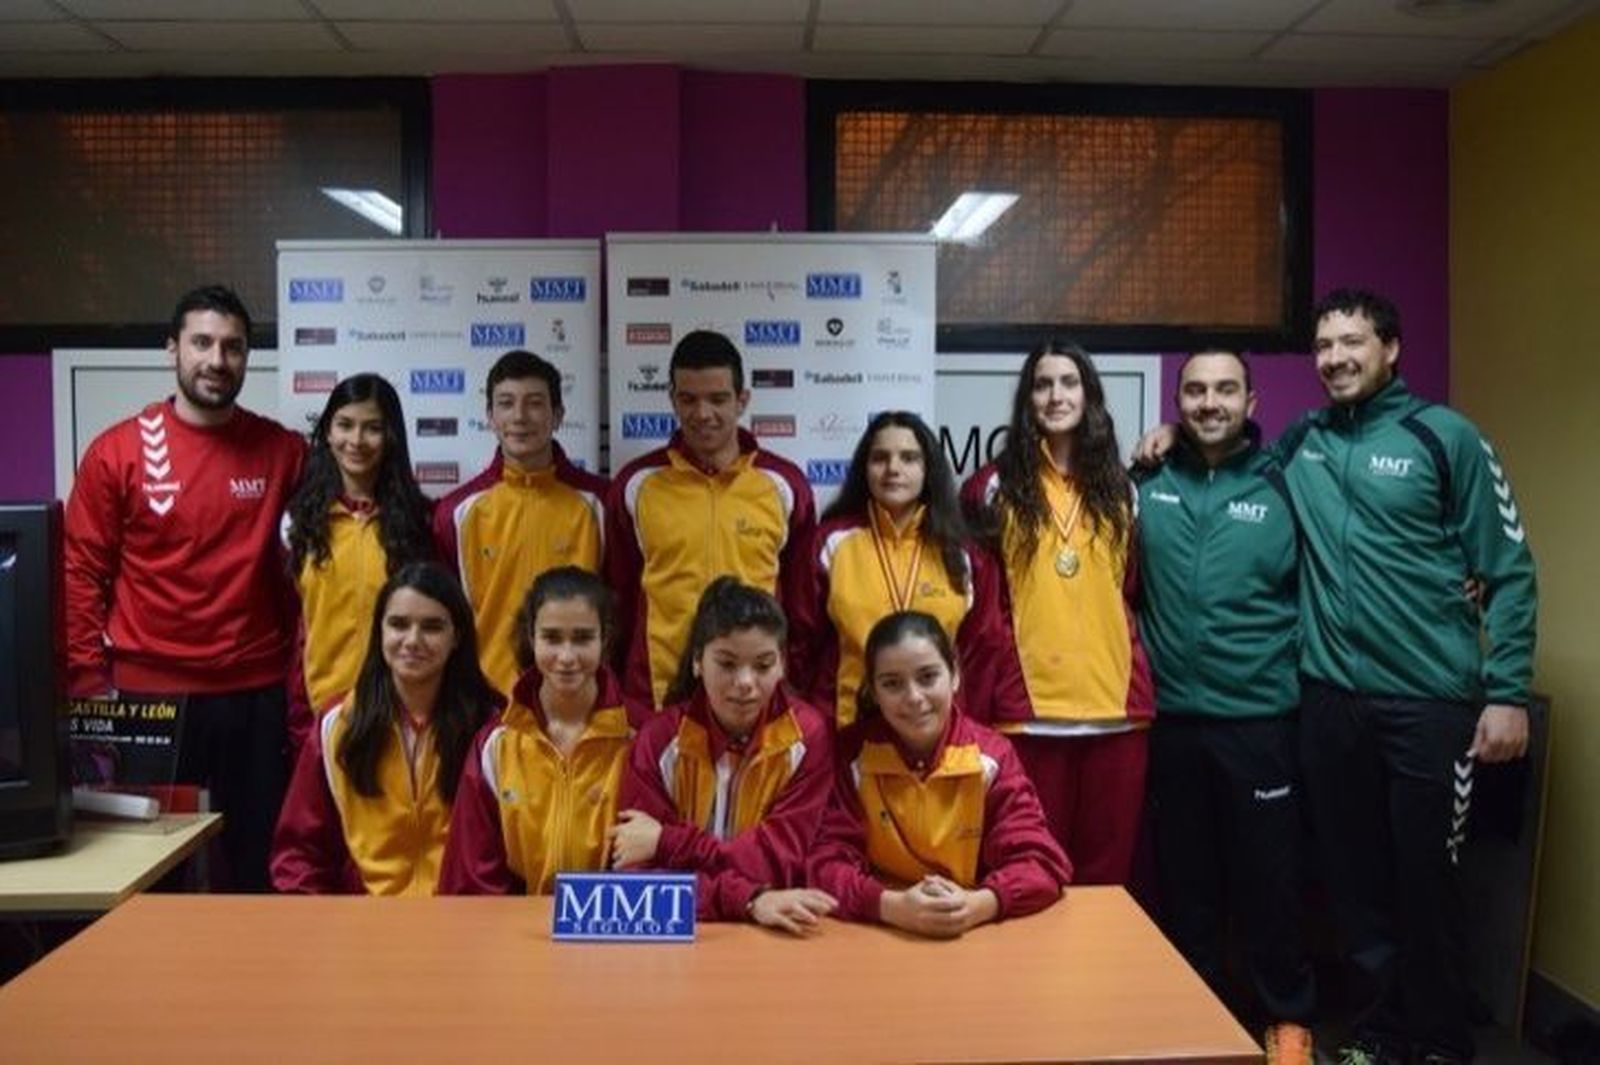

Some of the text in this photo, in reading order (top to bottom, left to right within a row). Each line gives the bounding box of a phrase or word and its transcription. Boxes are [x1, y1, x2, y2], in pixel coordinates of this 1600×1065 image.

[533, 281, 583, 297] MMT
[808, 275, 859, 294] MMT
[472, 326, 524, 343] MMT
[747, 324, 798, 340] MMT
[413, 372, 462, 389] MMT
[808, 461, 848, 480] MM
[1368, 457, 1412, 474] MMT
[230, 478, 266, 492] MMT
[1227, 501, 1268, 516] MMT
[70, 701, 176, 719] ASTILLA Y LEÓN
[82, 719, 114, 732] VIDA
[558, 883, 693, 922] MMT
